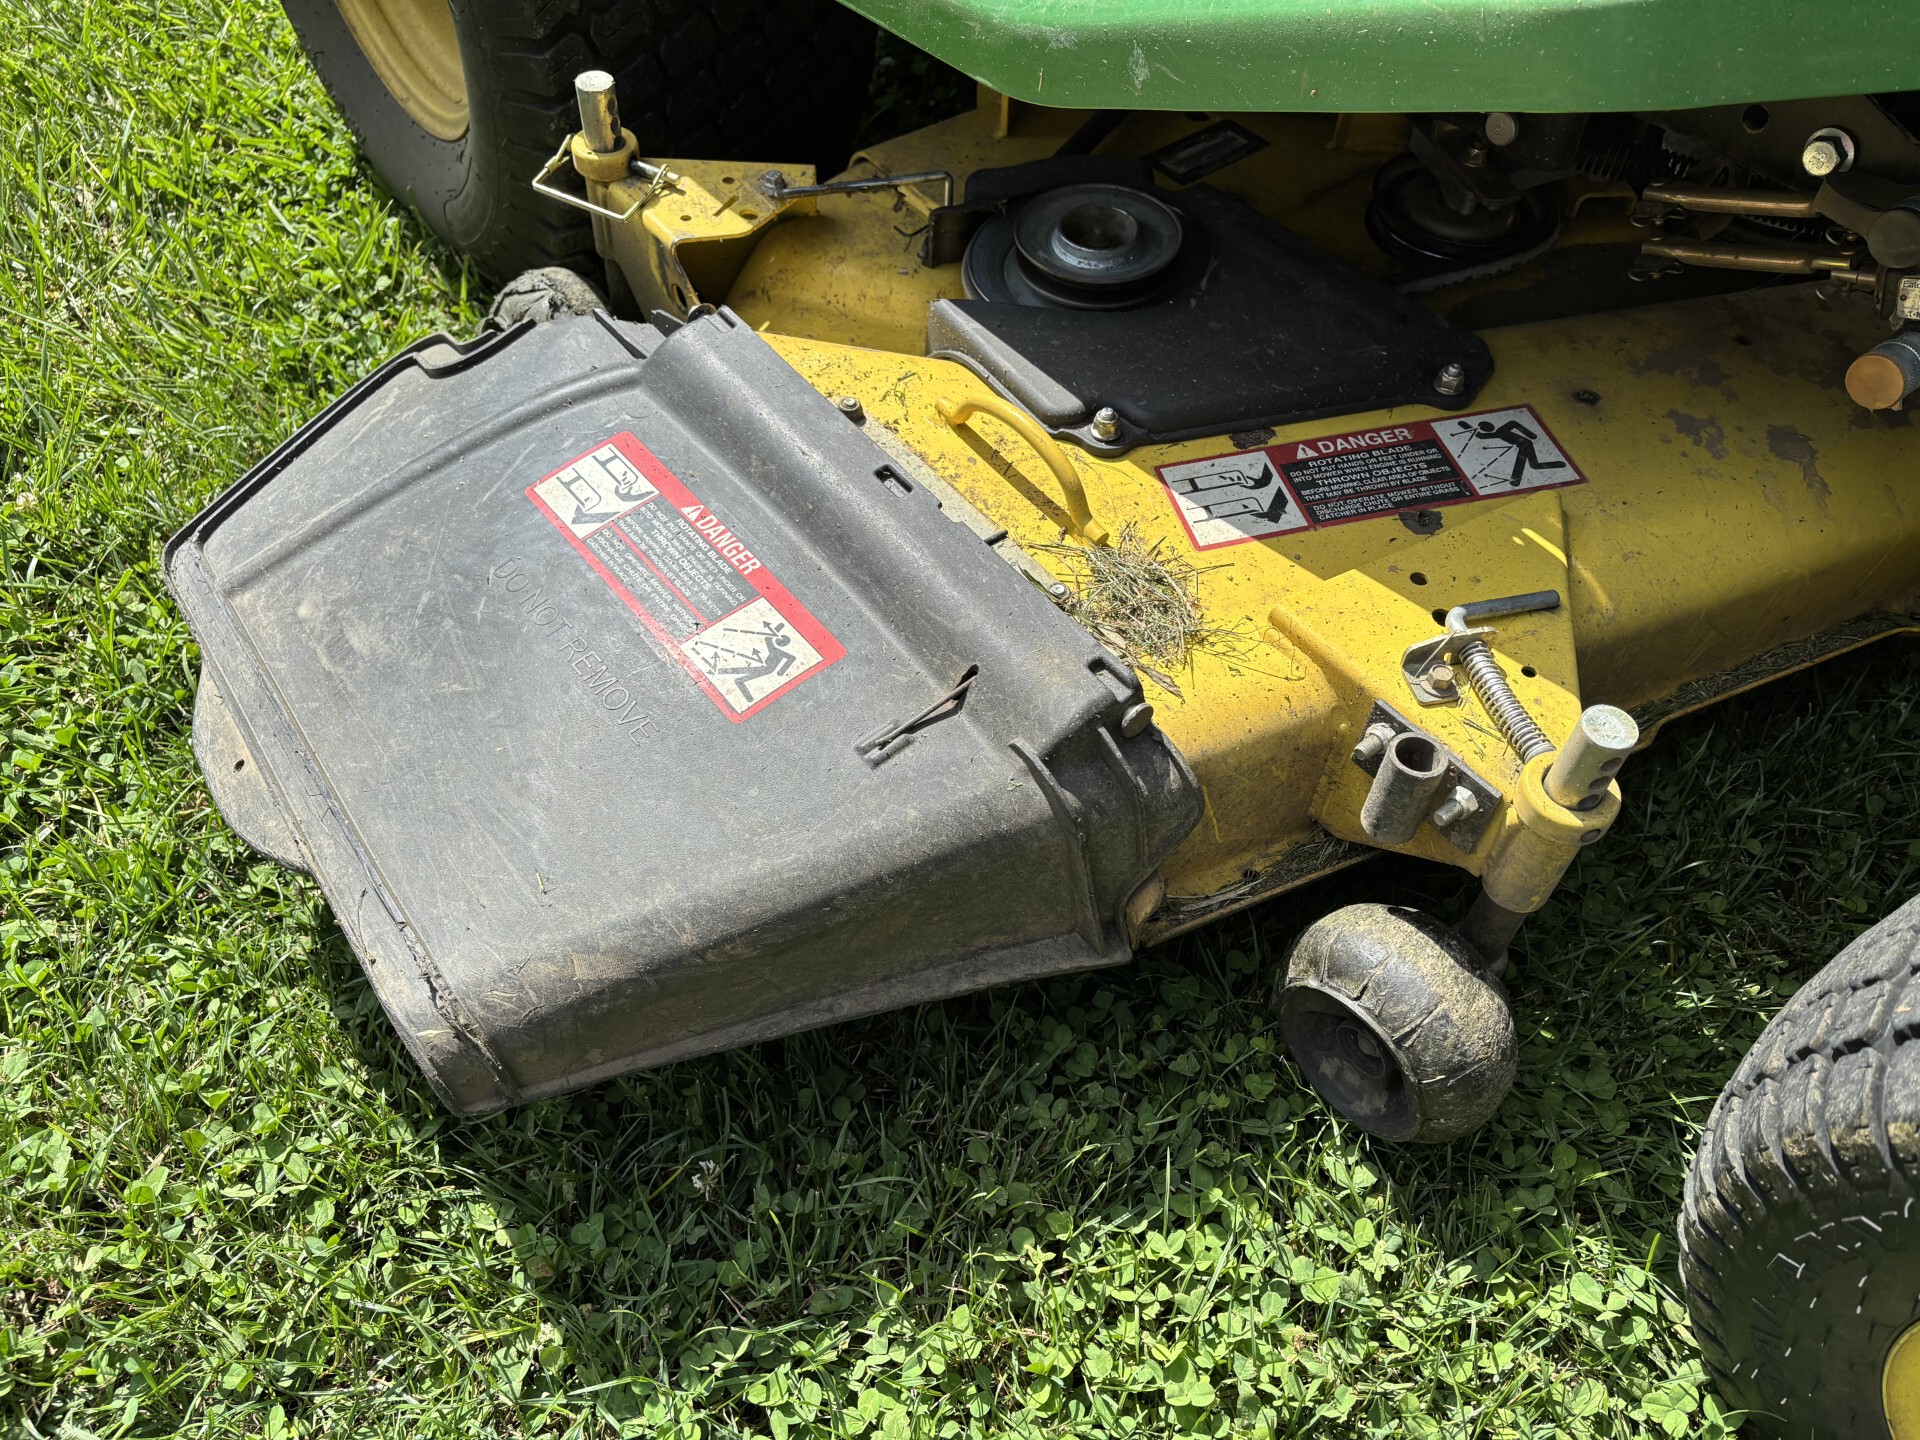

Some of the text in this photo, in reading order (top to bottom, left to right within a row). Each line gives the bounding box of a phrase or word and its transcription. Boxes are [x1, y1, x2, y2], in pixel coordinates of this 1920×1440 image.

[1316, 427, 1413, 453] DANGER
[1307, 444, 1412, 467] ROTATING BLADE
[1312, 469, 1343, 479] MOWER
[1343, 465, 1368, 473] WHEN
[1368, 460, 1397, 469] ENGINE
[1406, 452, 1442, 463] RUNNING
[1336, 459, 1365, 468] HANDS
[1377, 454, 1398, 462] FEET
[1398, 449, 1425, 458] UNDER
[1300, 486, 1331, 495] BEFORE
[1362, 476, 1388, 484] CLEAR
[1387, 472, 1408, 480] AREA
[1315, 461, 1428, 486] THROWN OBJECTS
[1304, 493, 1325, 501] THAT
[1325, 489, 1343, 497] MAY
[1354, 481, 1390, 492] THROWN
[1400, 475, 1428, 484] BLADE
[1315, 502, 1363, 515] DISCHARGE
[1403, 490, 1433, 500] ENTIRE
[1432, 485, 1460, 495] GRASS
[1346, 493, 1386, 504] OPERATE
[1386, 487, 1419, 497] MOWER
[1418, 481, 1457, 492] WITHOUT
[655, 510, 668, 522] NOT
[1318, 509, 1357, 520] CATCHER
[1367, 502, 1394, 511] PLACE
[674, 517, 733, 574] ROTATING BLADE
[694, 513, 762, 576] DANGER
[650, 528, 712, 590] THROWN OBJECTS
[518, 587, 573, 643] NOT
[553, 632, 663, 747] REMOVE
